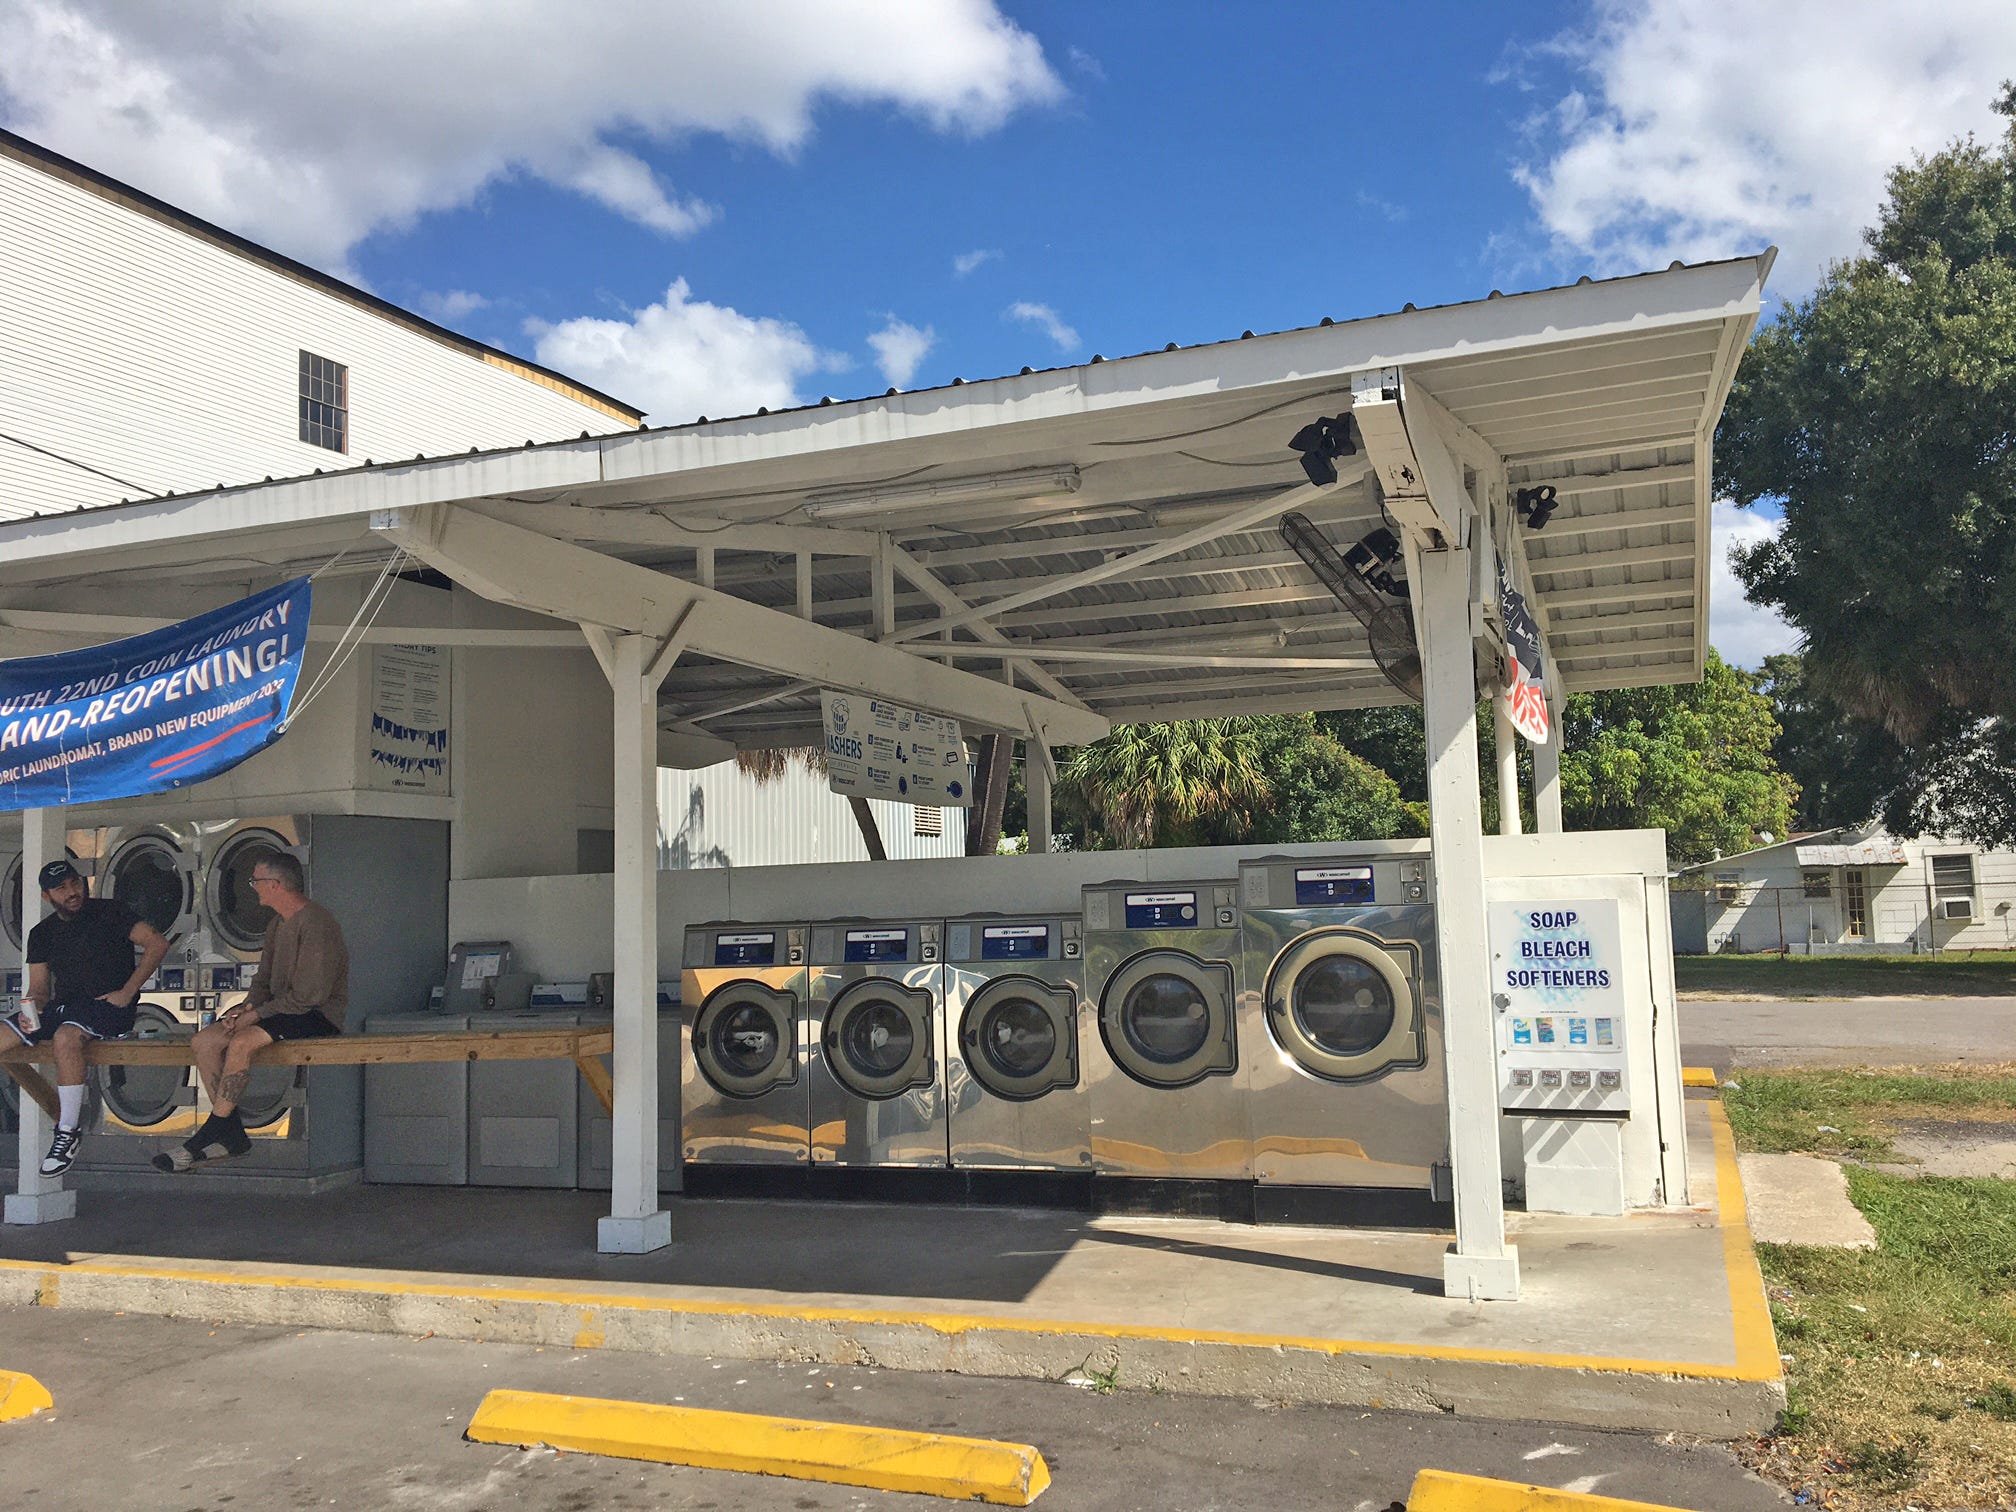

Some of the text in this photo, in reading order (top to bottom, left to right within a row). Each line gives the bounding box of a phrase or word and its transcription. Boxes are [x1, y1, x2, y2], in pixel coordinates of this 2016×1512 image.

[0, 599, 290, 717] UTH 22ND COIN LAUNDRY
[22, 742, 107, 778] LAUNDROMAT,
[109, 727, 153, 752] BRAND
[156, 716, 187, 738] NEW
[190, 691, 258, 728] EQUIPMENT
[1530, 911, 1577, 928] SOAP
[186, 948, 193, 963] 6
[1521, 940, 1590, 957] BLEACH
[1507, 969, 1609, 987] SOFTENERS
